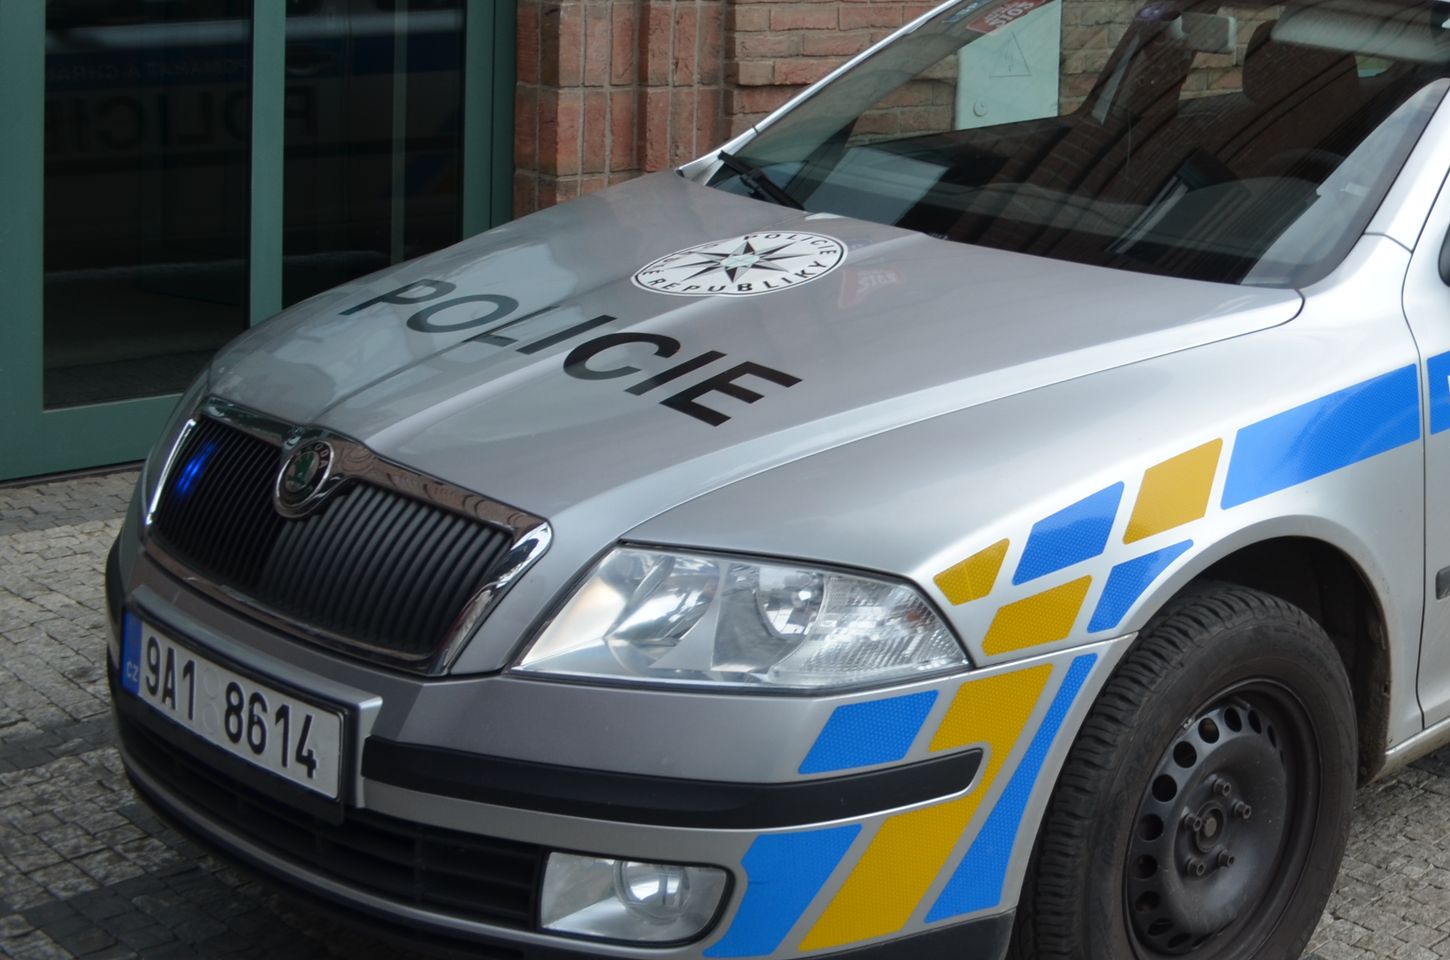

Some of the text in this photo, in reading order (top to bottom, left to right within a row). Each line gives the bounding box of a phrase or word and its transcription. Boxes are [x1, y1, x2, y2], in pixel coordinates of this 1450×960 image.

[647, 260, 829, 293] REPUBLIKY
[338, 277, 803, 428] POLICIE
[126, 660, 138, 682] CZ
[145, 636, 318, 780] 9A1 8614
